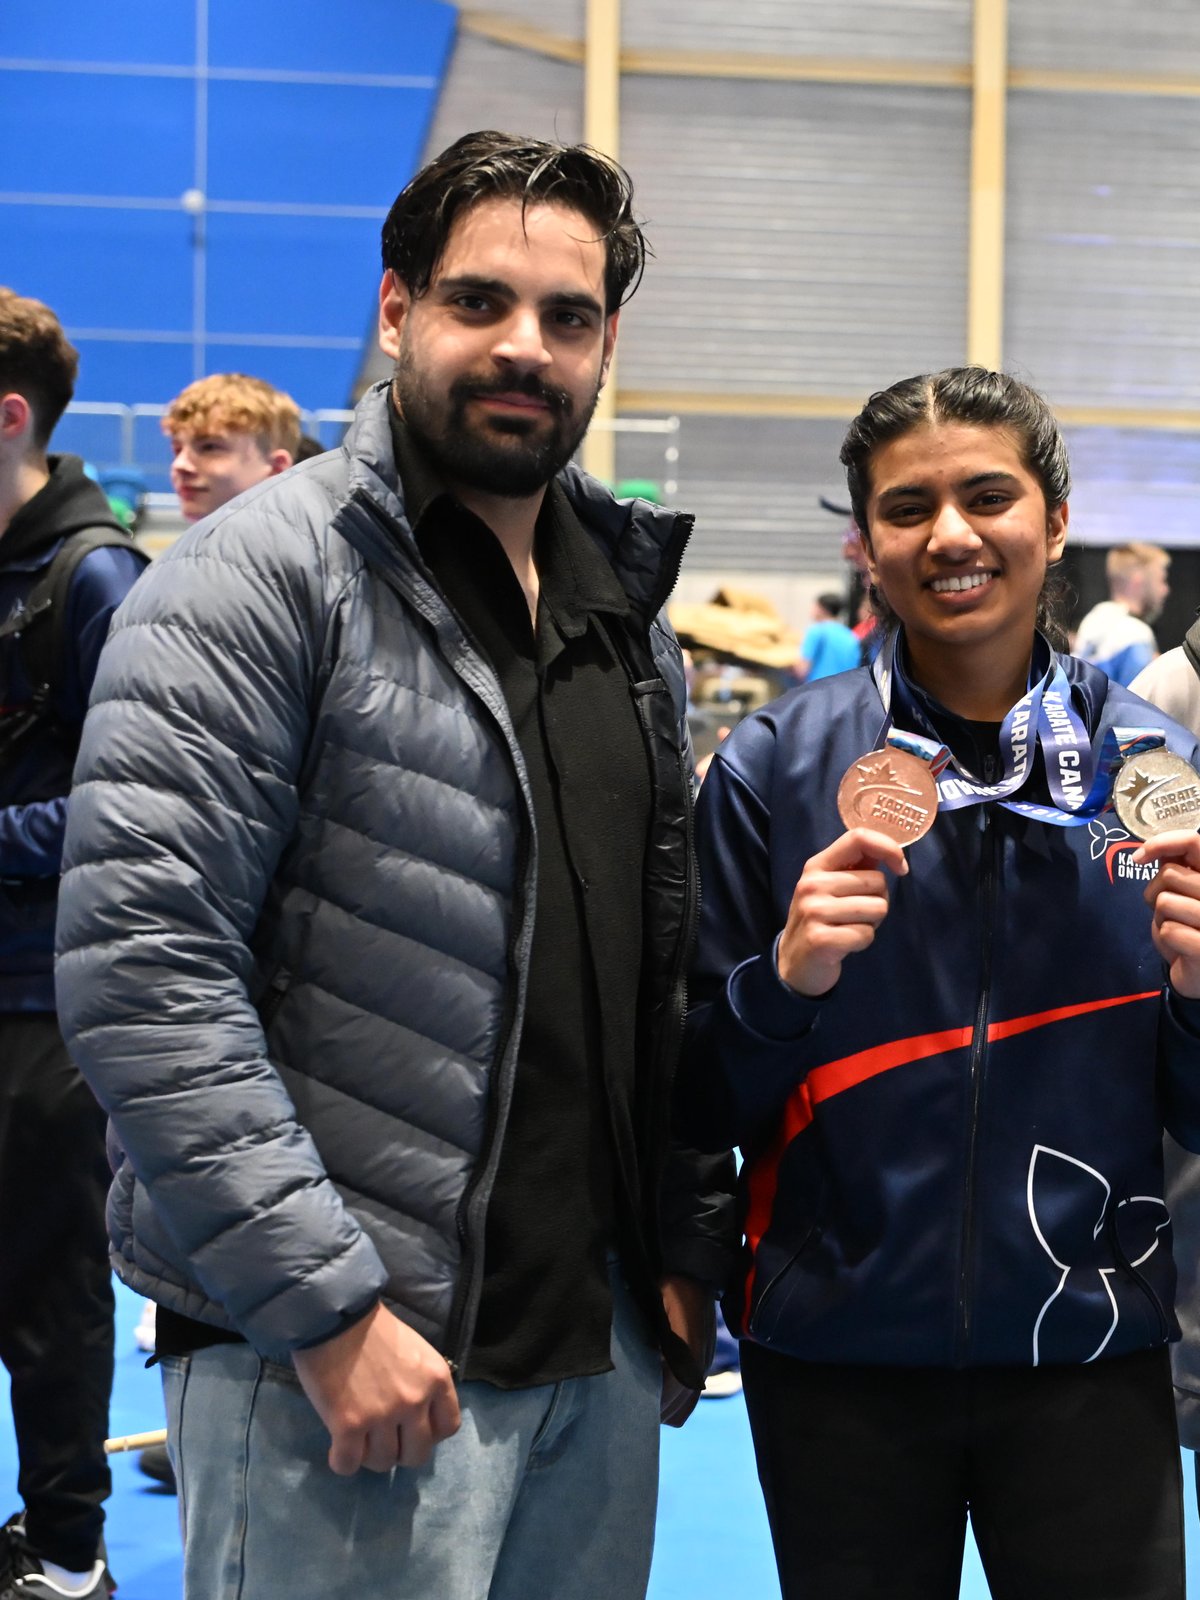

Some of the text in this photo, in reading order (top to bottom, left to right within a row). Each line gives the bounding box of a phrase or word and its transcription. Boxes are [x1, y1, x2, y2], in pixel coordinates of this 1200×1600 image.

[1042, 690, 1078, 747] KARATE
[875, 791, 930, 825] KARATE
[1150, 784, 1200, 810] KARATE
[871, 804, 924, 837] CANADA
